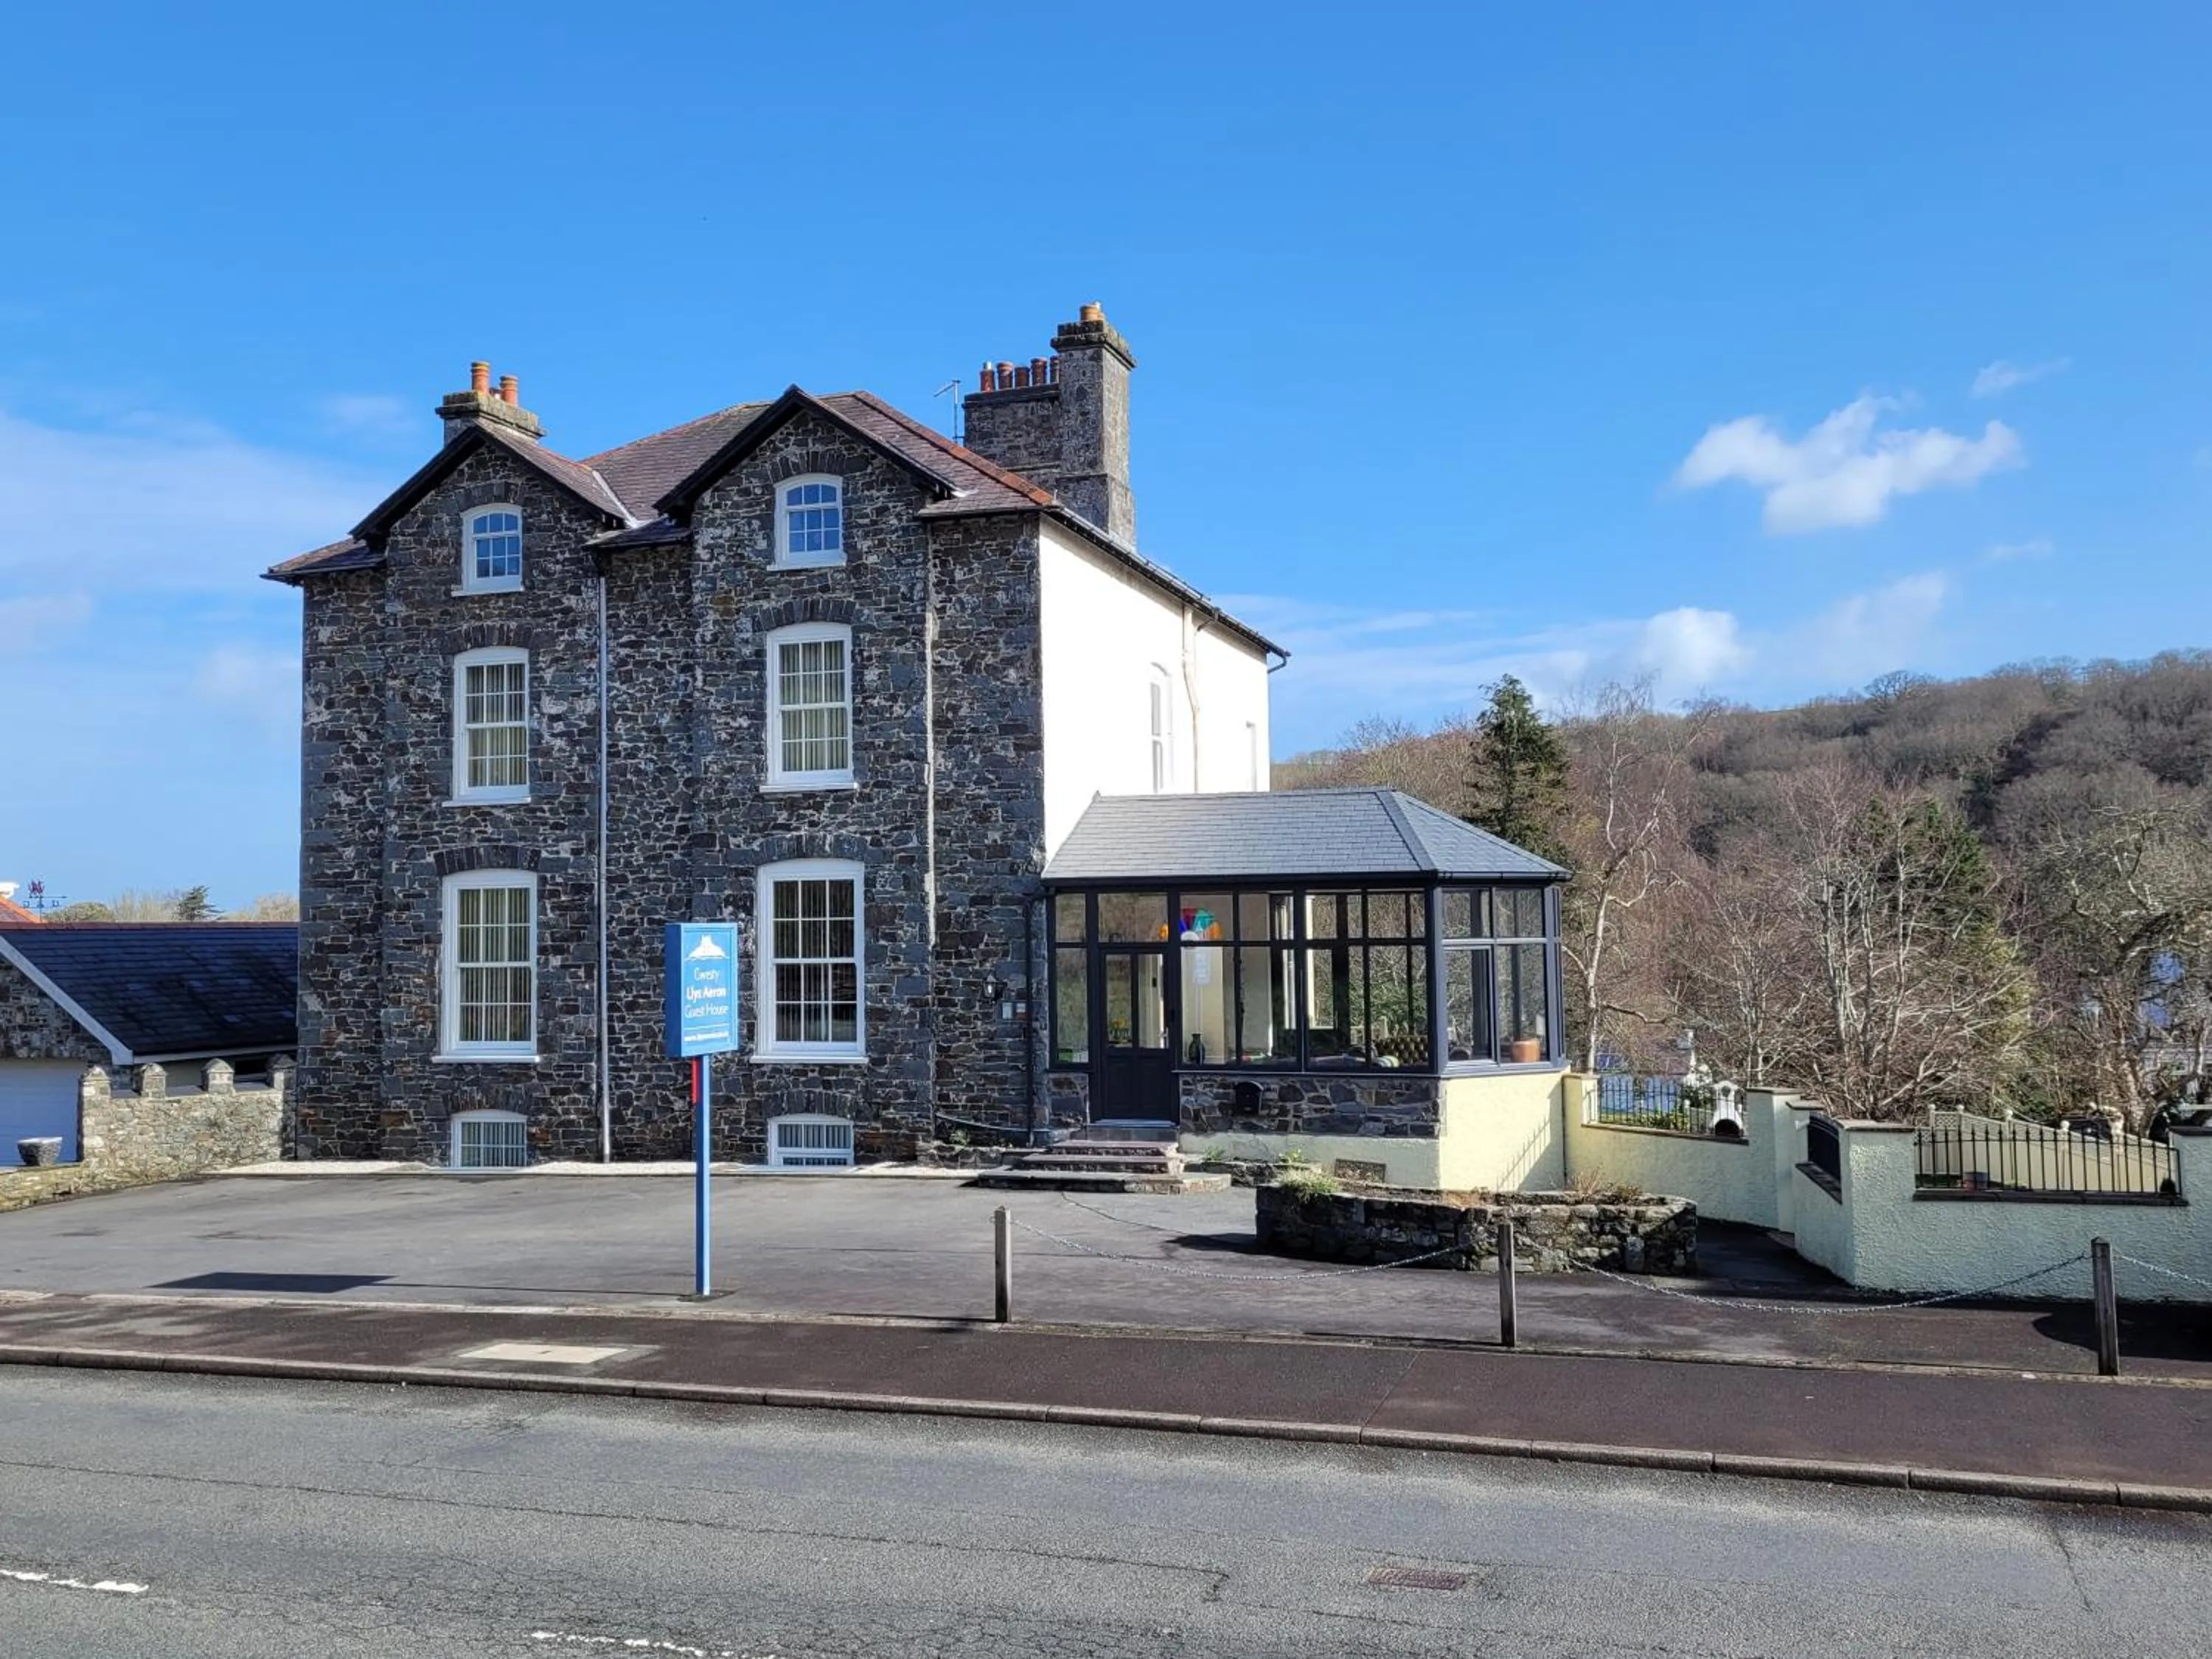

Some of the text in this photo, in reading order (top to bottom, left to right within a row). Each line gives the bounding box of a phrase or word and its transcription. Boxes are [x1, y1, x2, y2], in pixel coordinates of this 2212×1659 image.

[703, 986, 726, 998] Aeron
[684, 1003, 729, 1018] Guest House
